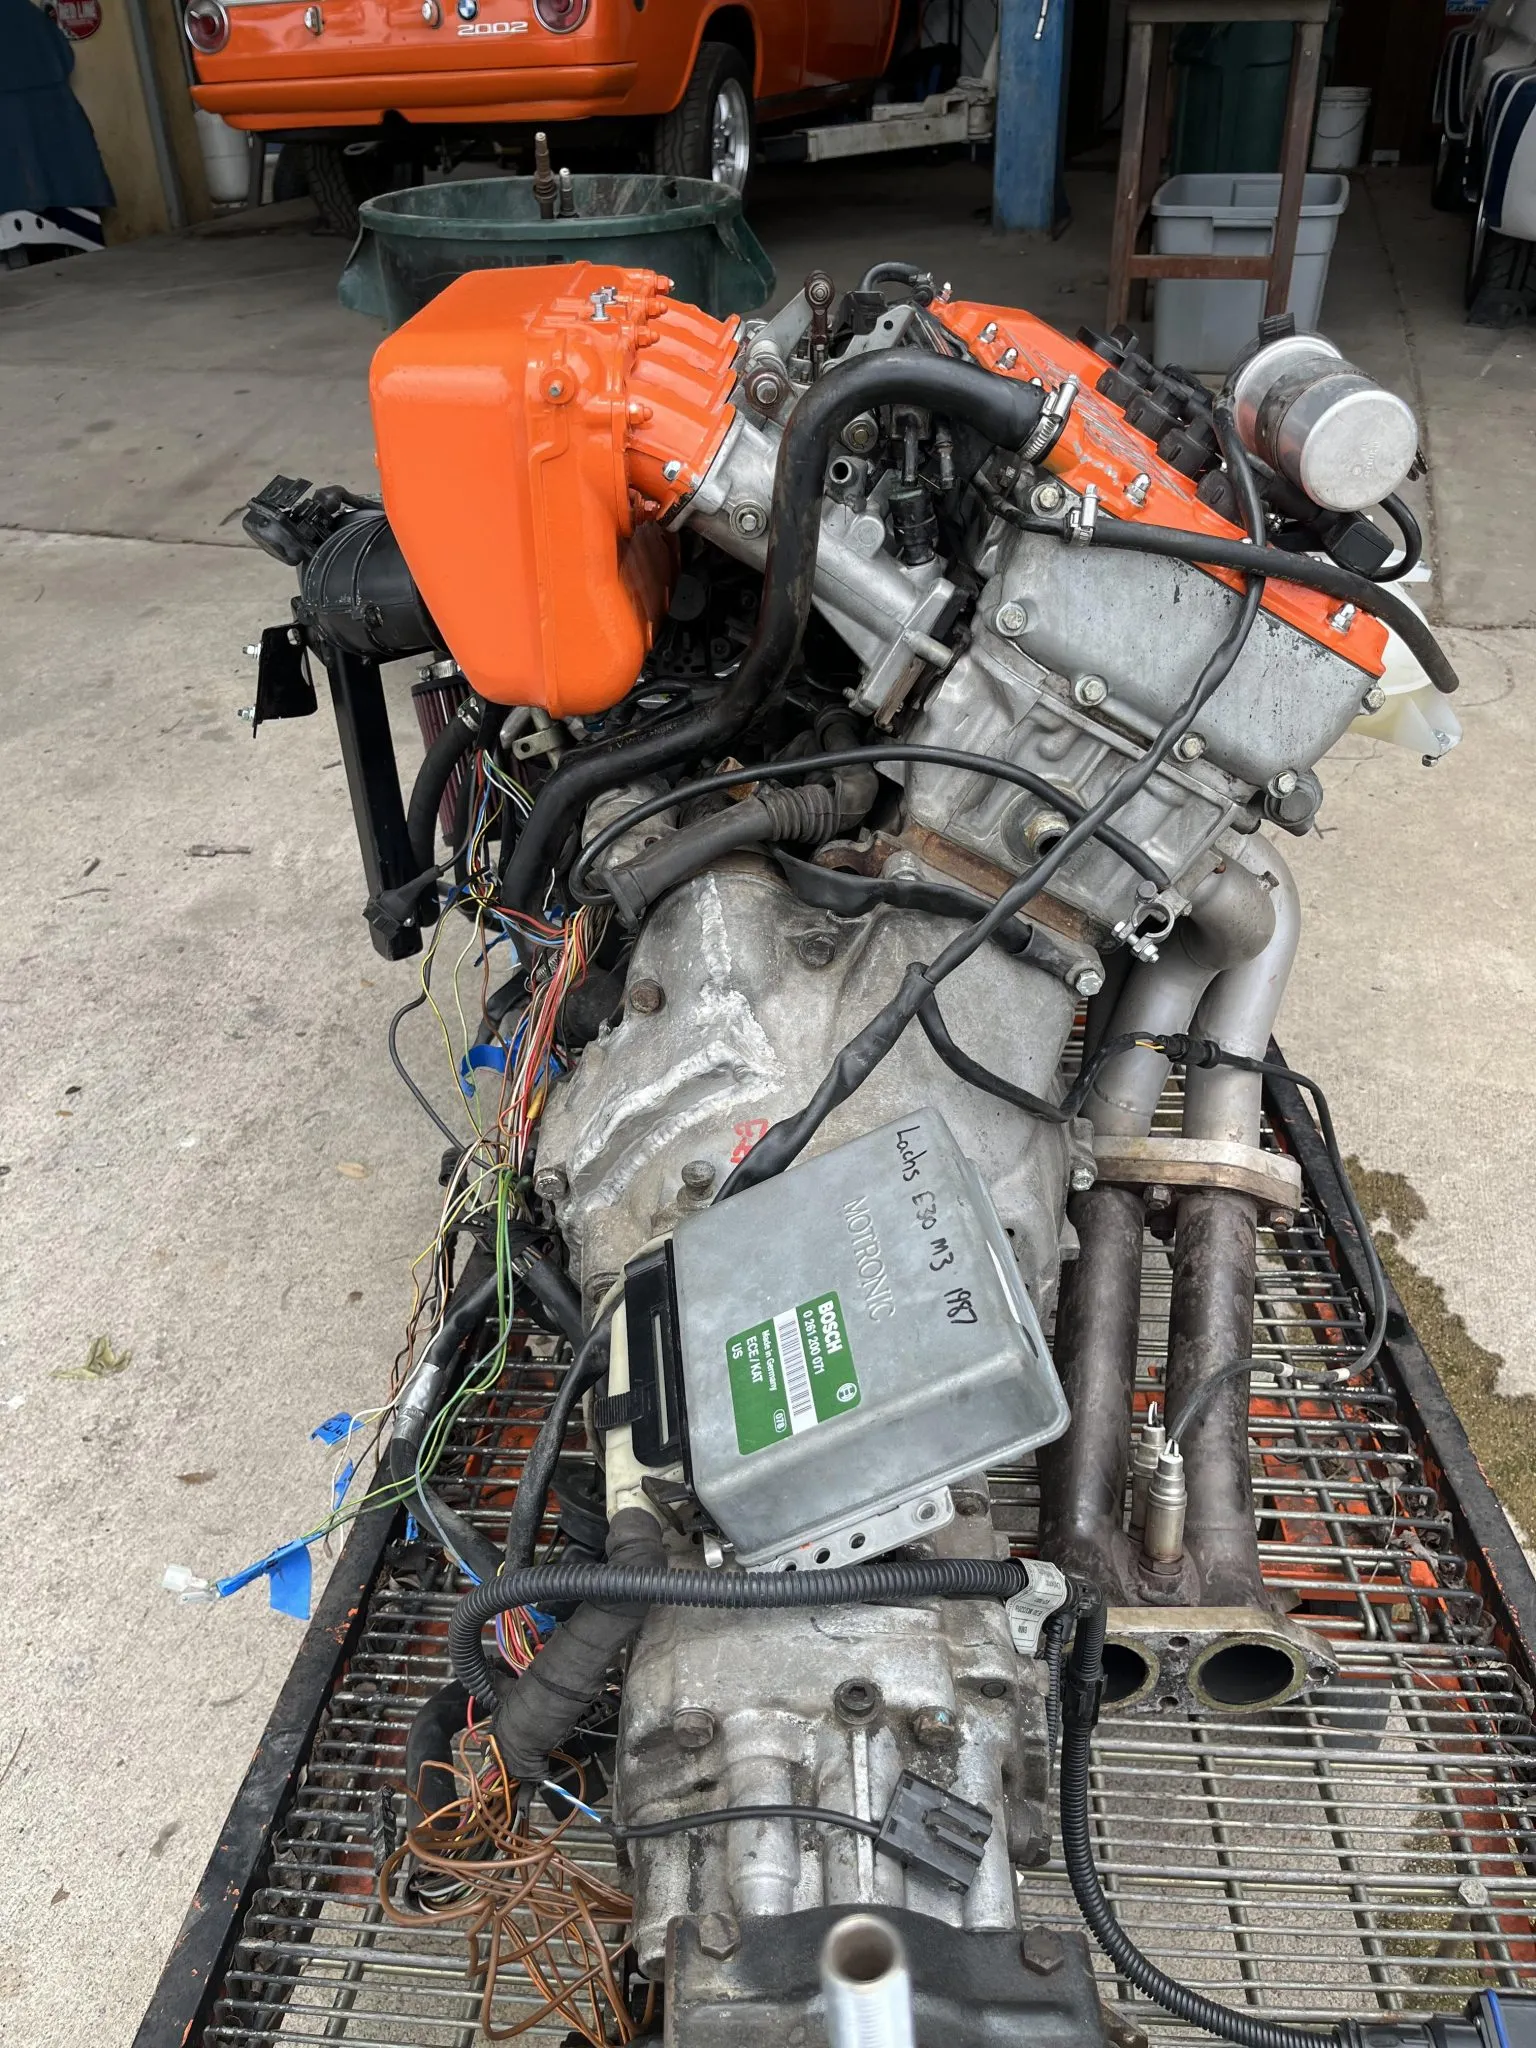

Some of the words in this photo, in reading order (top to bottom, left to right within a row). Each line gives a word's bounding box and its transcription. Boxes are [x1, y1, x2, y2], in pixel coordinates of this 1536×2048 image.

[457, 21, 528, 36] 2002
[896, 1125, 928, 1182] Lachs
[912, 1191, 937, 1230] E30
[929, 1237, 954, 1271] M3
[944, 1287, 978, 1323] 1987
[842, 1195, 896, 1323] MOTRONIC
[803, 1309, 814, 1319] 0
[804, 1317, 817, 1337] 261
[818, 1300, 843, 1355] BOSCH
[761, 1329, 772, 1349] Made
[808, 1335, 821, 1356] 200
[731, 1342, 743, 1360] US
[764, 1347, 772, 1358] in
[766, 1358, 778, 1391] Germany
[811, 1355, 825, 1375] 071
